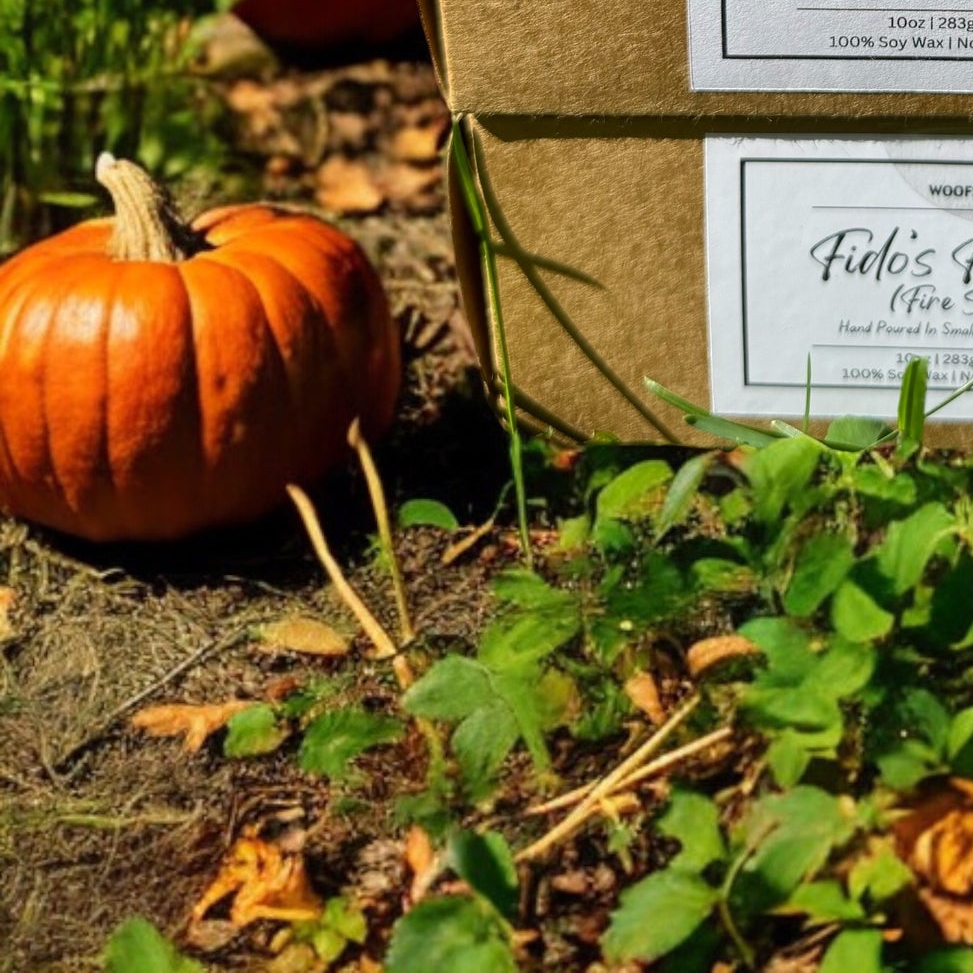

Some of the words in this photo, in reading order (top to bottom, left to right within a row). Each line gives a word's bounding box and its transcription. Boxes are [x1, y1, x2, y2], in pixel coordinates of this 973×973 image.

[887, 16, 926, 29] 10oz
[829, 35, 875, 48] 100%
[878, 35, 908, 51] Soy
[912, 36, 944, 49] Wax
[810, 226, 936, 281] Fido's
[890, 283, 955, 314] (Fire
[838, 319, 873, 333] Hand
[875, 319, 922, 334] Poured
[925, 320, 938, 334] In
[842, 368, 884, 379] 100%
